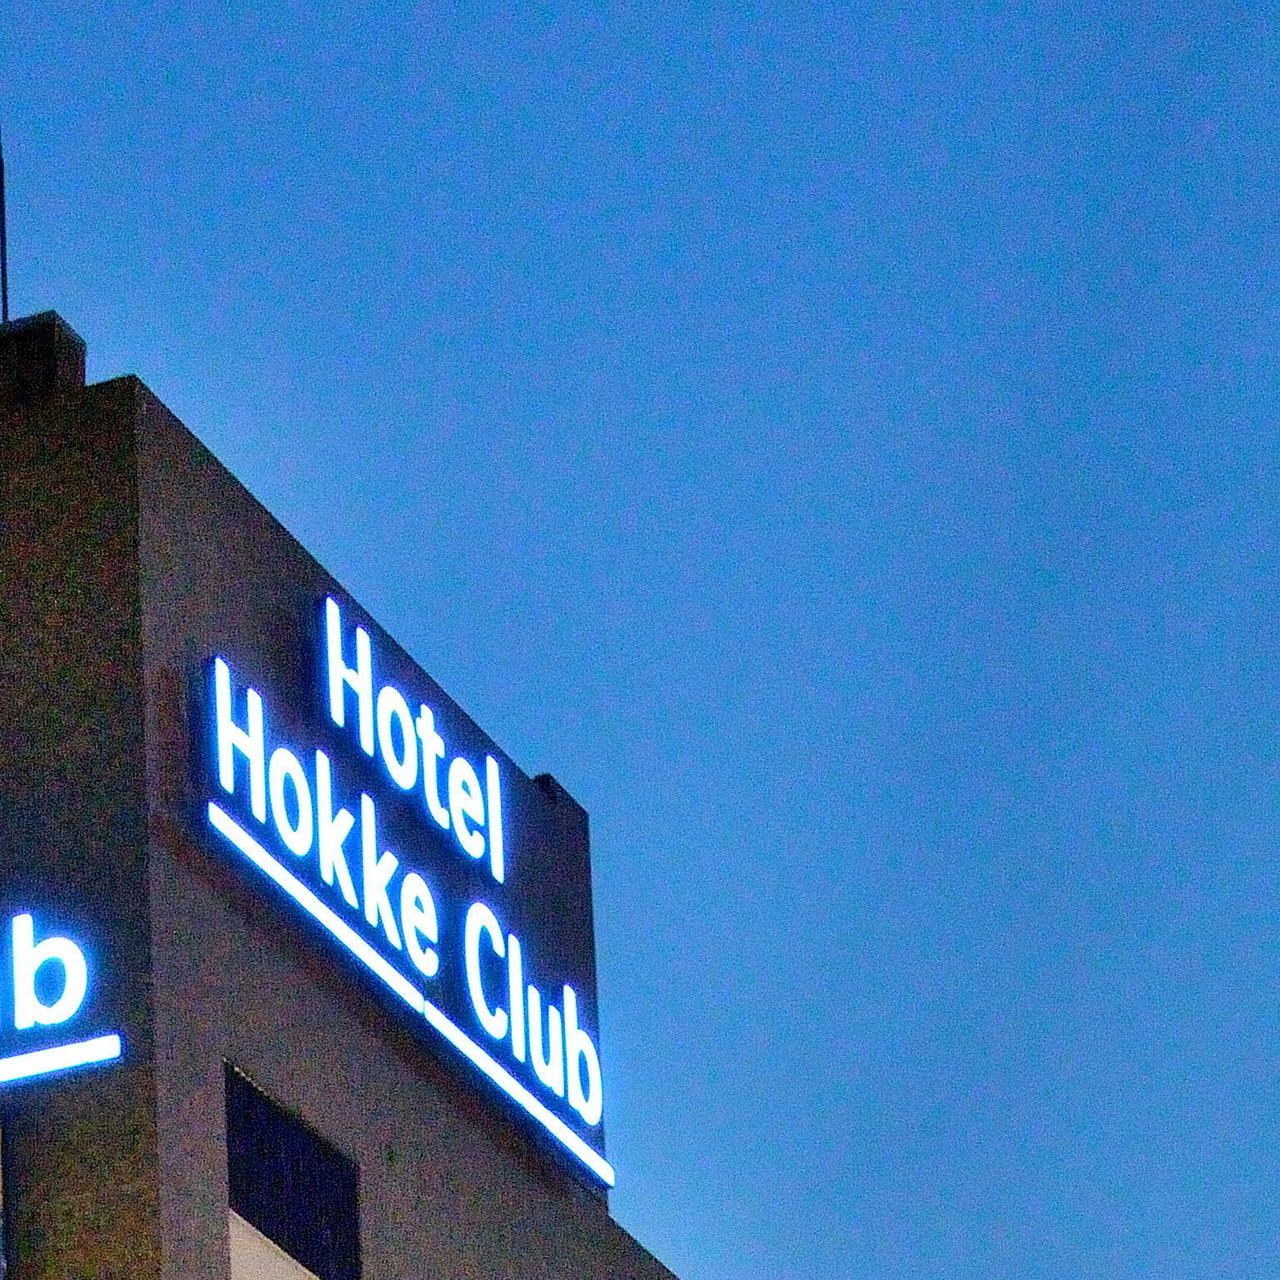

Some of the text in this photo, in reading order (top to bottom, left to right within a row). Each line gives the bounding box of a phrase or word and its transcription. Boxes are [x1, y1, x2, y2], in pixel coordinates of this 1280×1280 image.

[214, 656, 603, 1127] Hokke Club
[326, 596, 505, 884] Hotel
